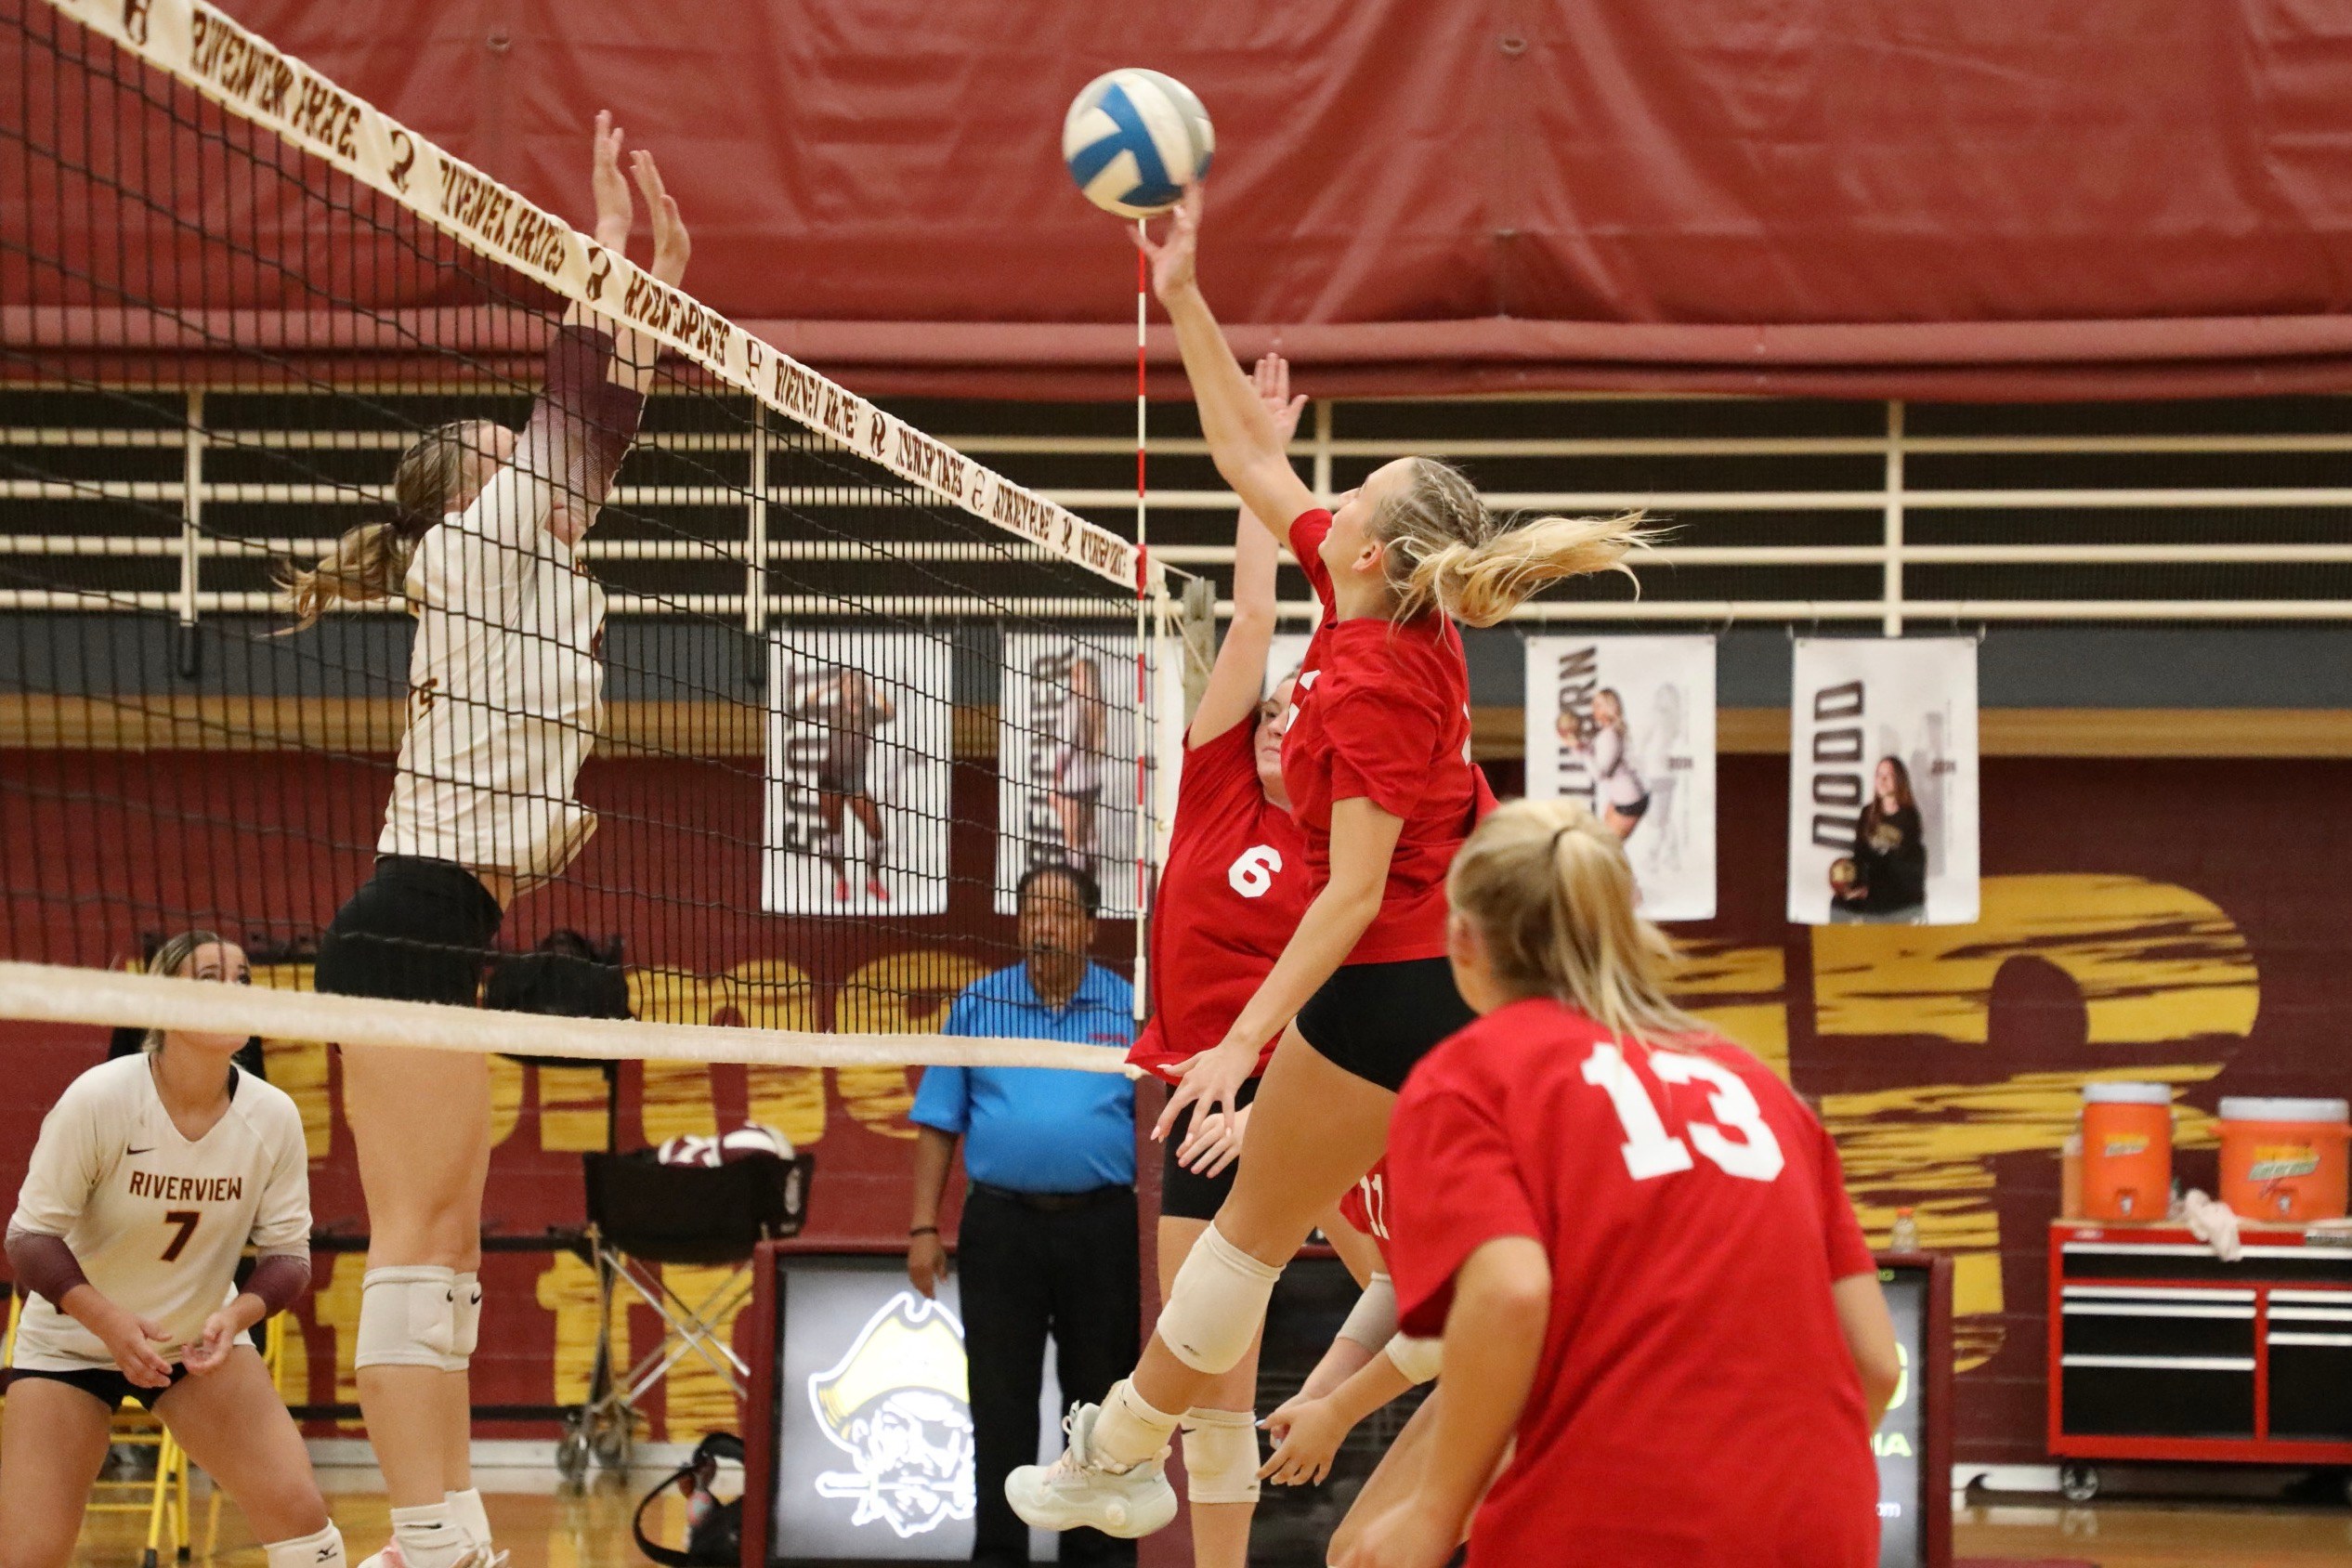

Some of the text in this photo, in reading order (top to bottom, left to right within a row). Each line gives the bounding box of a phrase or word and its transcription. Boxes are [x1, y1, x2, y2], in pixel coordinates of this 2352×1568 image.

[1228, 843, 1283, 898] 6
[1580, 1040, 1786, 1183] 13
[128, 1170, 242, 1201] RIVERVIEW
[1359, 1174, 1391, 1240] 11
[160, 1210, 201, 1262] 7
